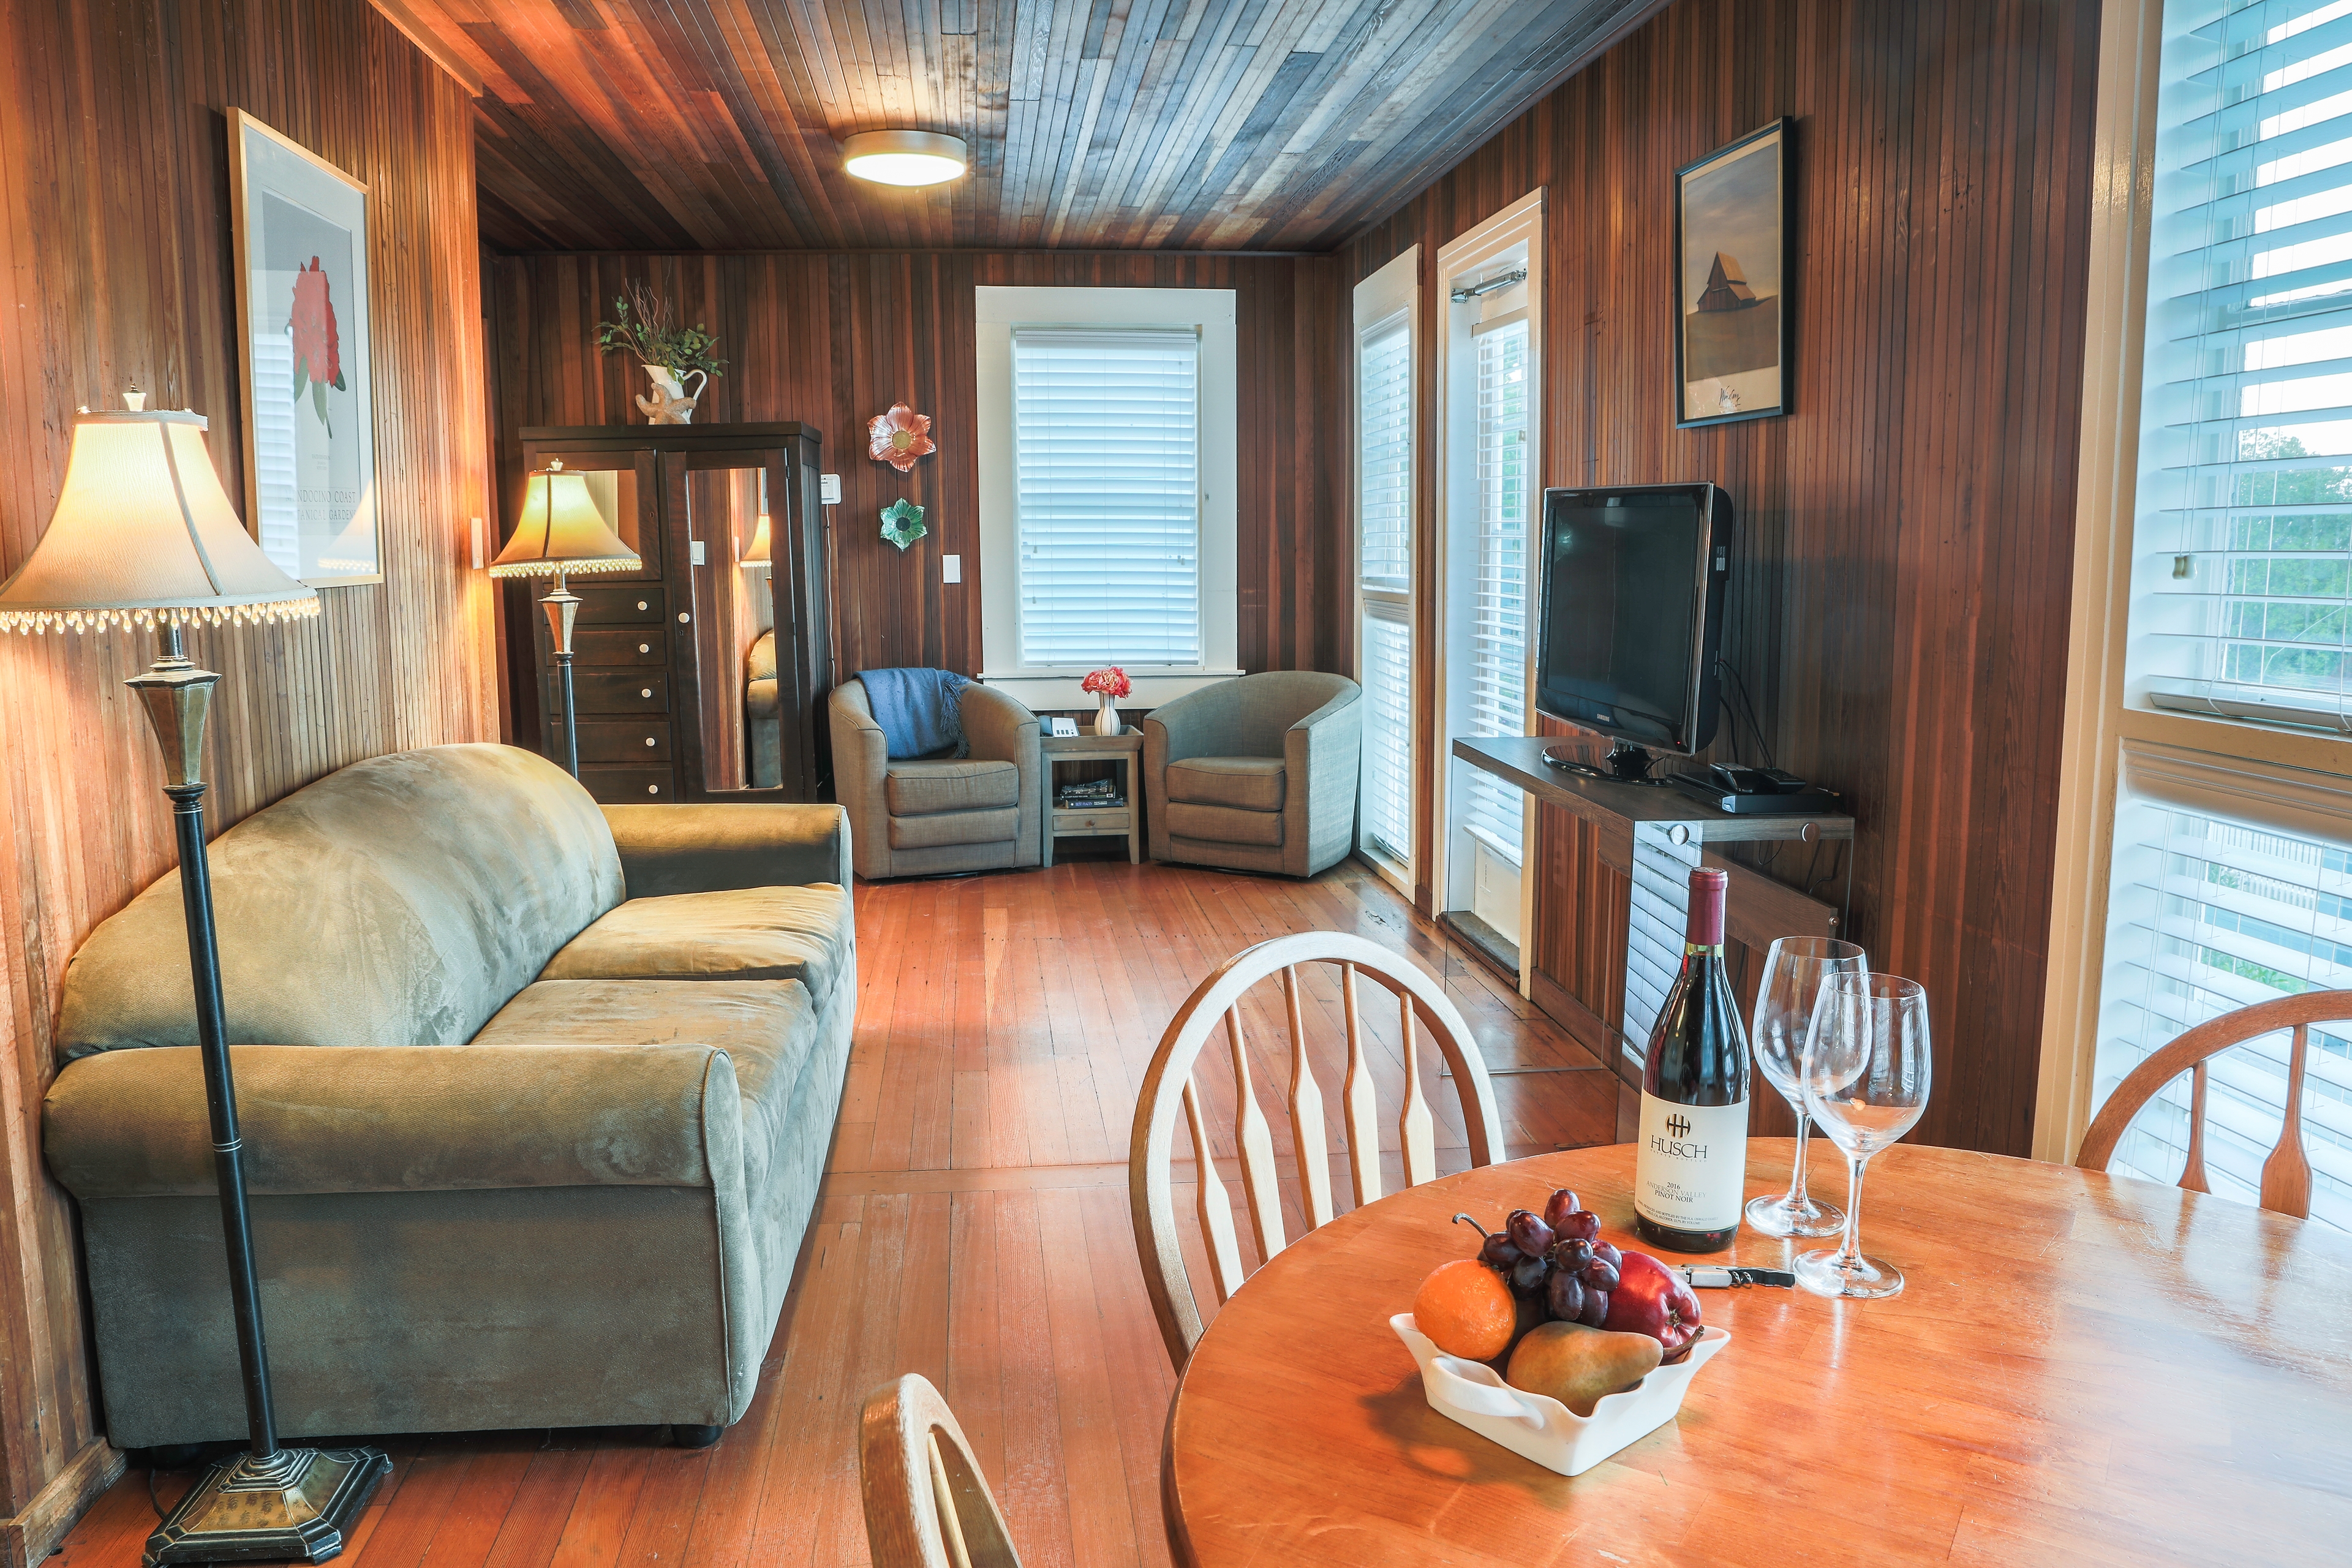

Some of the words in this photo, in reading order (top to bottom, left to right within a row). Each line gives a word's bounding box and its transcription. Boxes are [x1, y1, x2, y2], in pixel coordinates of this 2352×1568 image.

[334, 491, 356, 503] COAST
[287, 509, 326, 521] TANICAL
[1597, 713, 1610, 722] SAMSUNG
[1651, 1134, 1708, 1159] HUSCH
[1650, 1148, 1671, 1158] ESTATE
[1646, 1180, 1679, 1195] ANDERSON
[1667, 1182, 1681, 1190] 2016
[1654, 1189, 1675, 1200] PINOT
